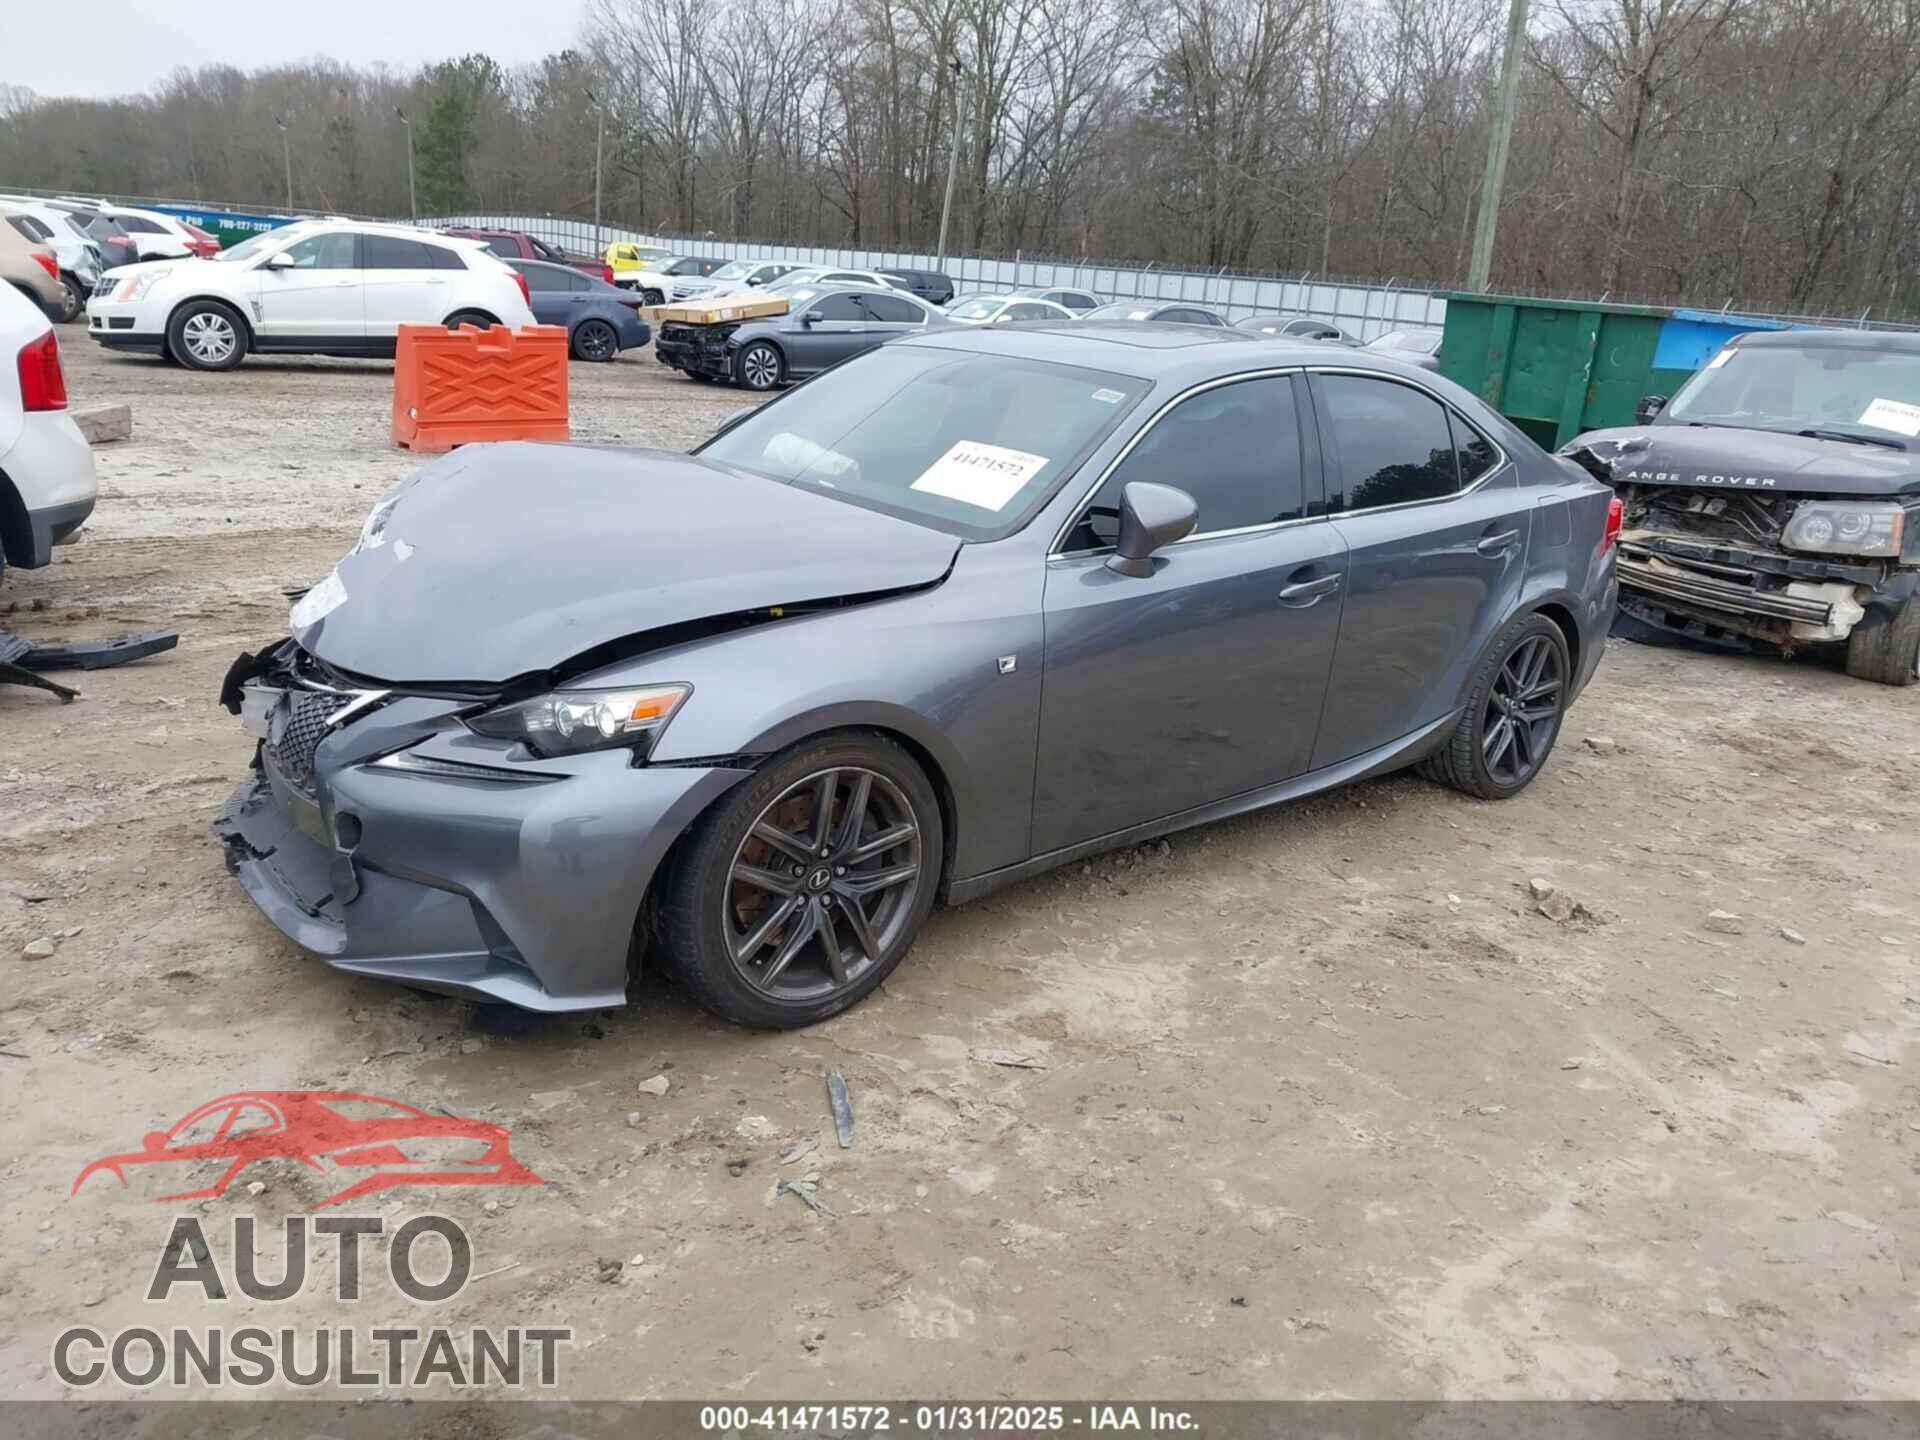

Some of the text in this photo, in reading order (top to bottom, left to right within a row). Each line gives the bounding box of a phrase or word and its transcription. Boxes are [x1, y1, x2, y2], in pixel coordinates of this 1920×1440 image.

[951, 452, 1025, 476] 41471572
[1627, 471, 1776, 486] ANGE ROVER
